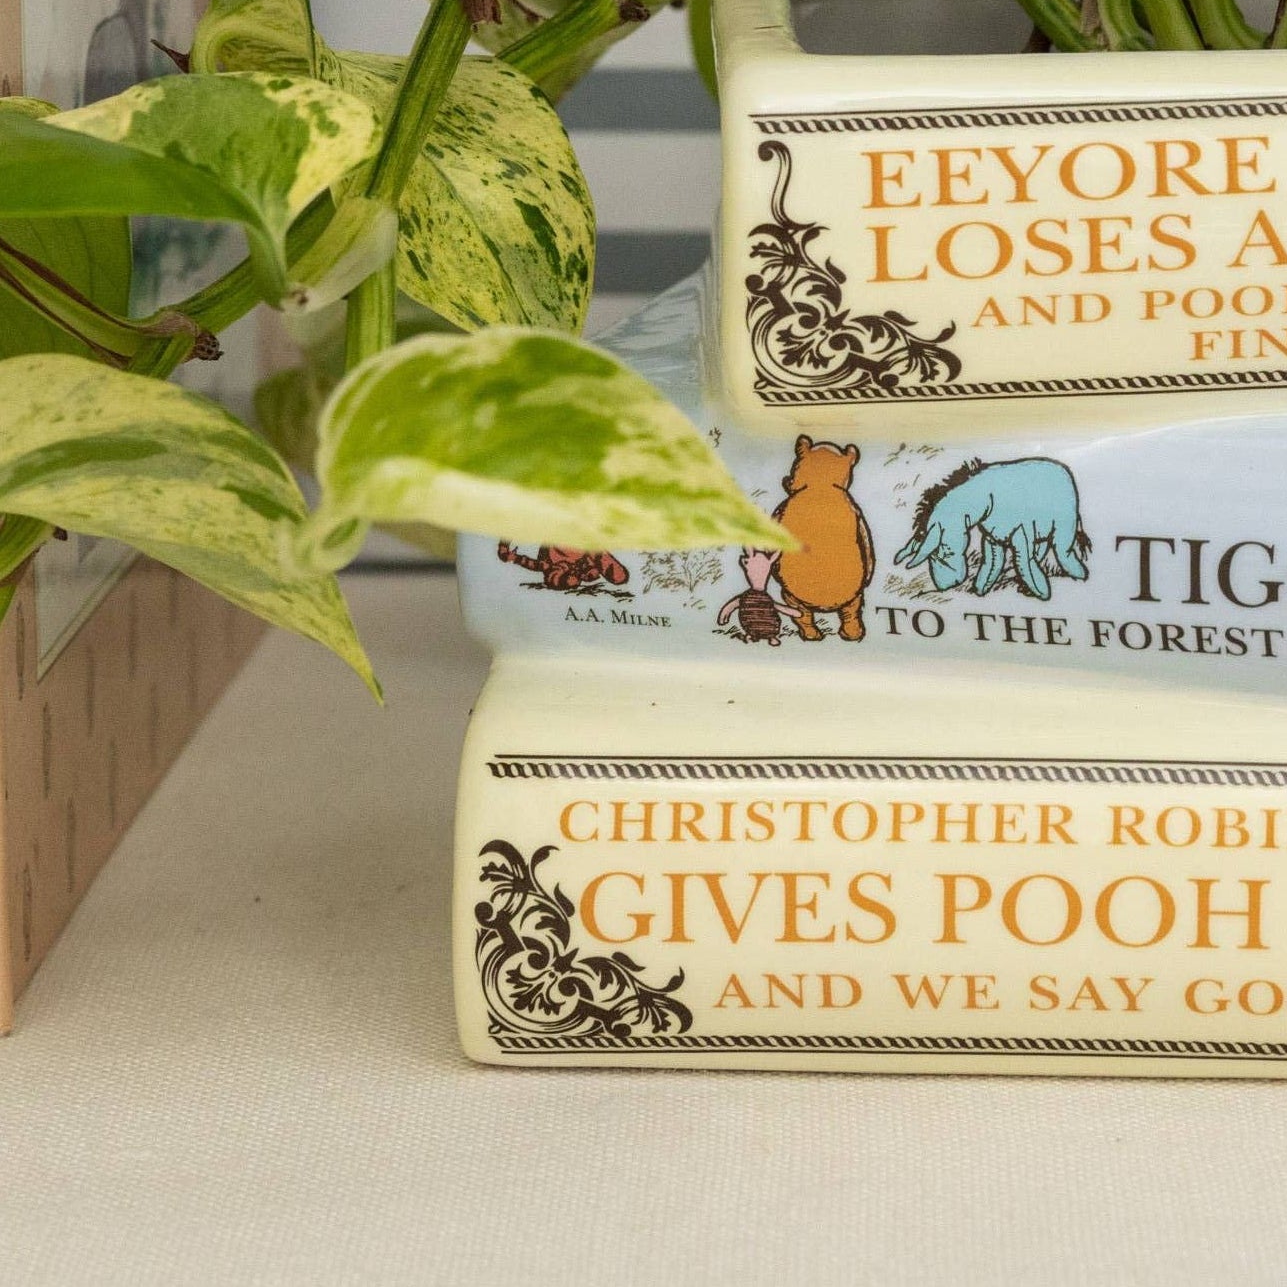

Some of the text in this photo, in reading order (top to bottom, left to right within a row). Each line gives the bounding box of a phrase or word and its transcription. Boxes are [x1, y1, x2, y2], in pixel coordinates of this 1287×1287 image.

[860, 135, 1277, 210] EEYORE
[865, 213, 1197, 284] LOSES
[970, 293, 1113, 328] AND
[565, 606, 605, 623] A.A.
[875, 605, 946, 639] TO
[963, 612, 1073, 648] THE
[1088, 619, 1285, 660] FOREST
[558, 799, 1079, 847] CHRISTOPHER
[579, 870, 897, 946] GIVES
[933, 873, 1272, 952] POOH
[713, 973, 864, 1010] AND
[892, 974, 1000, 1011] WE
[1029, 975, 1154, 1013] SAY
